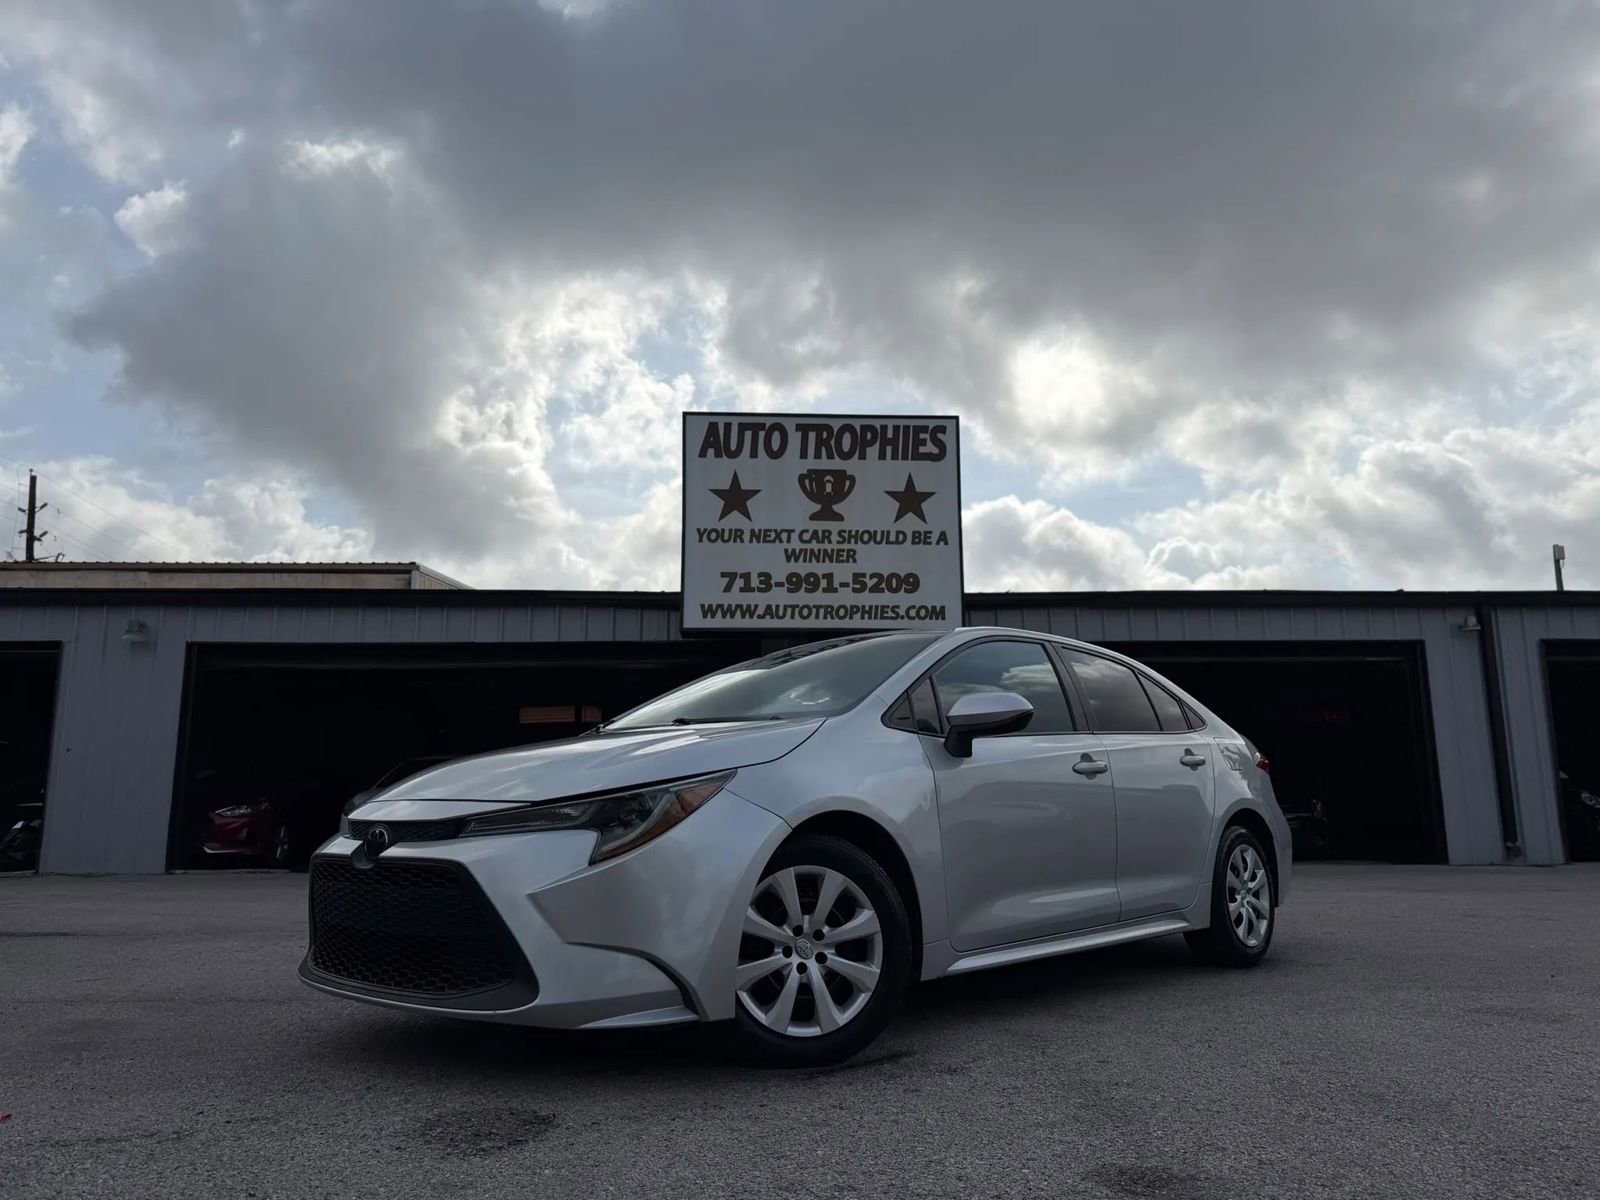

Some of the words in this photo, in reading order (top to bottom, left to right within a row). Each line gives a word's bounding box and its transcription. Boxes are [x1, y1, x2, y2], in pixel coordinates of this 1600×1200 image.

[698, 422, 789, 459] AUTO
[795, 423, 947, 462] TROPHIES
[696, 528, 744, 543] YOUR
[749, 529, 795, 543] NEXT
[798, 529, 832, 544] CAR
[837, 530, 907, 545] SHOULD
[911, 531, 932, 545] BE
[936, 531, 949, 545] A
[784, 548, 857, 563] WINNER
[720, 572, 920, 593] 713-991-5209
[700, 603, 946, 621] WWW.AUTOTROPHIES.COM
